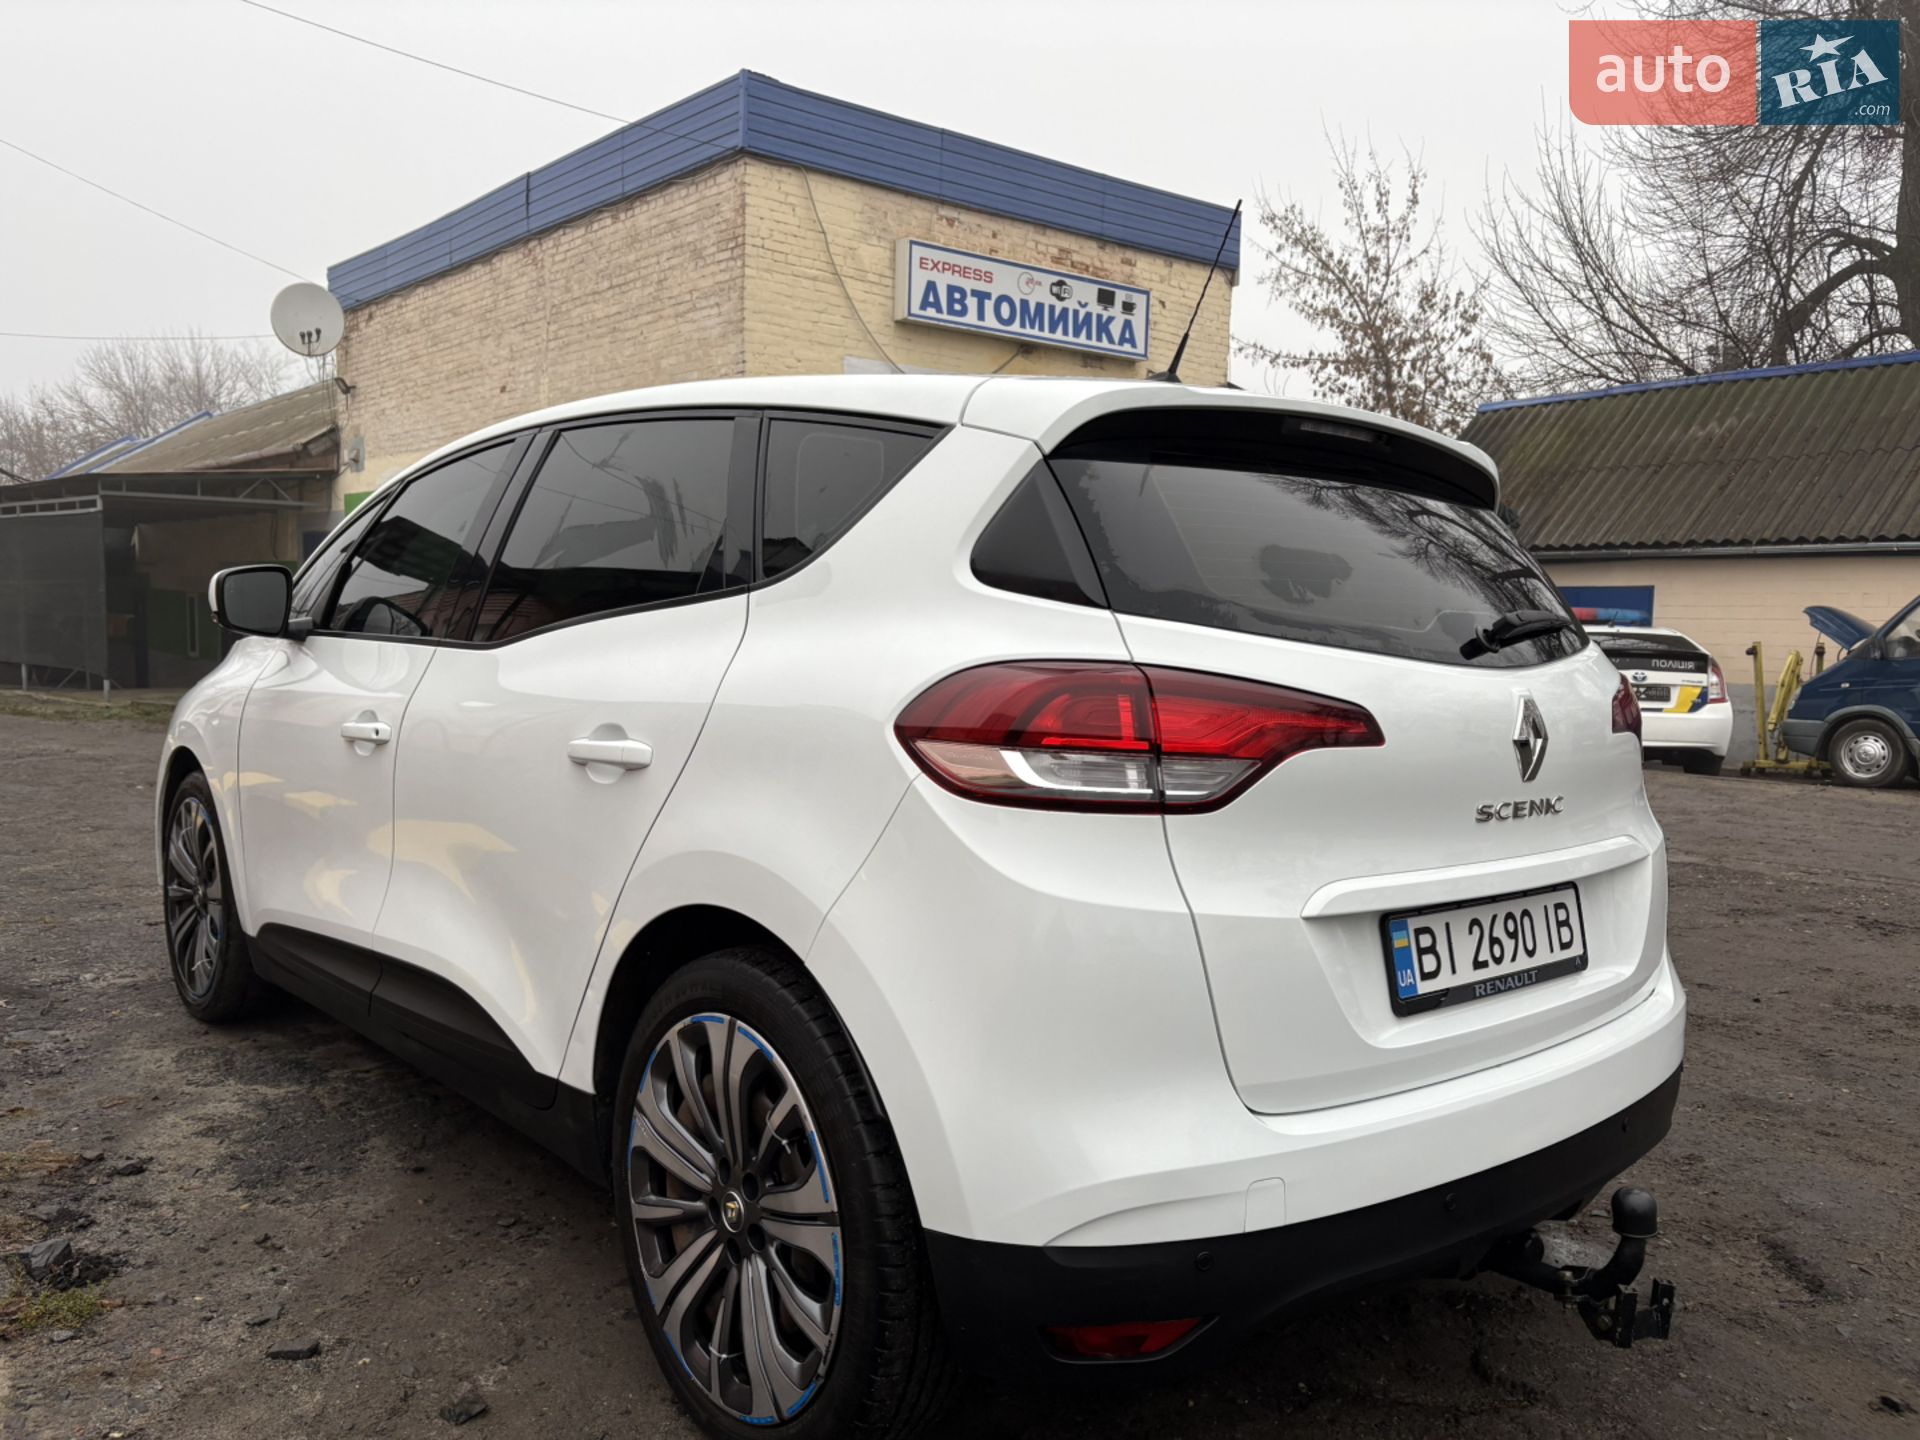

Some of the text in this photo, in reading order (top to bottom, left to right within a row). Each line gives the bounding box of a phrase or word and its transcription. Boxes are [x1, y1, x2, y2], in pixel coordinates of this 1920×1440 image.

[919, 257, 994, 283] EXPRESS
[919, 280, 1138, 349] АВТОМИЙКА
[1414, 902, 1574, 981] BI 2690 IB
[1399, 968, 1415, 987] UA
[1474, 970, 1538, 997] RENAULT
